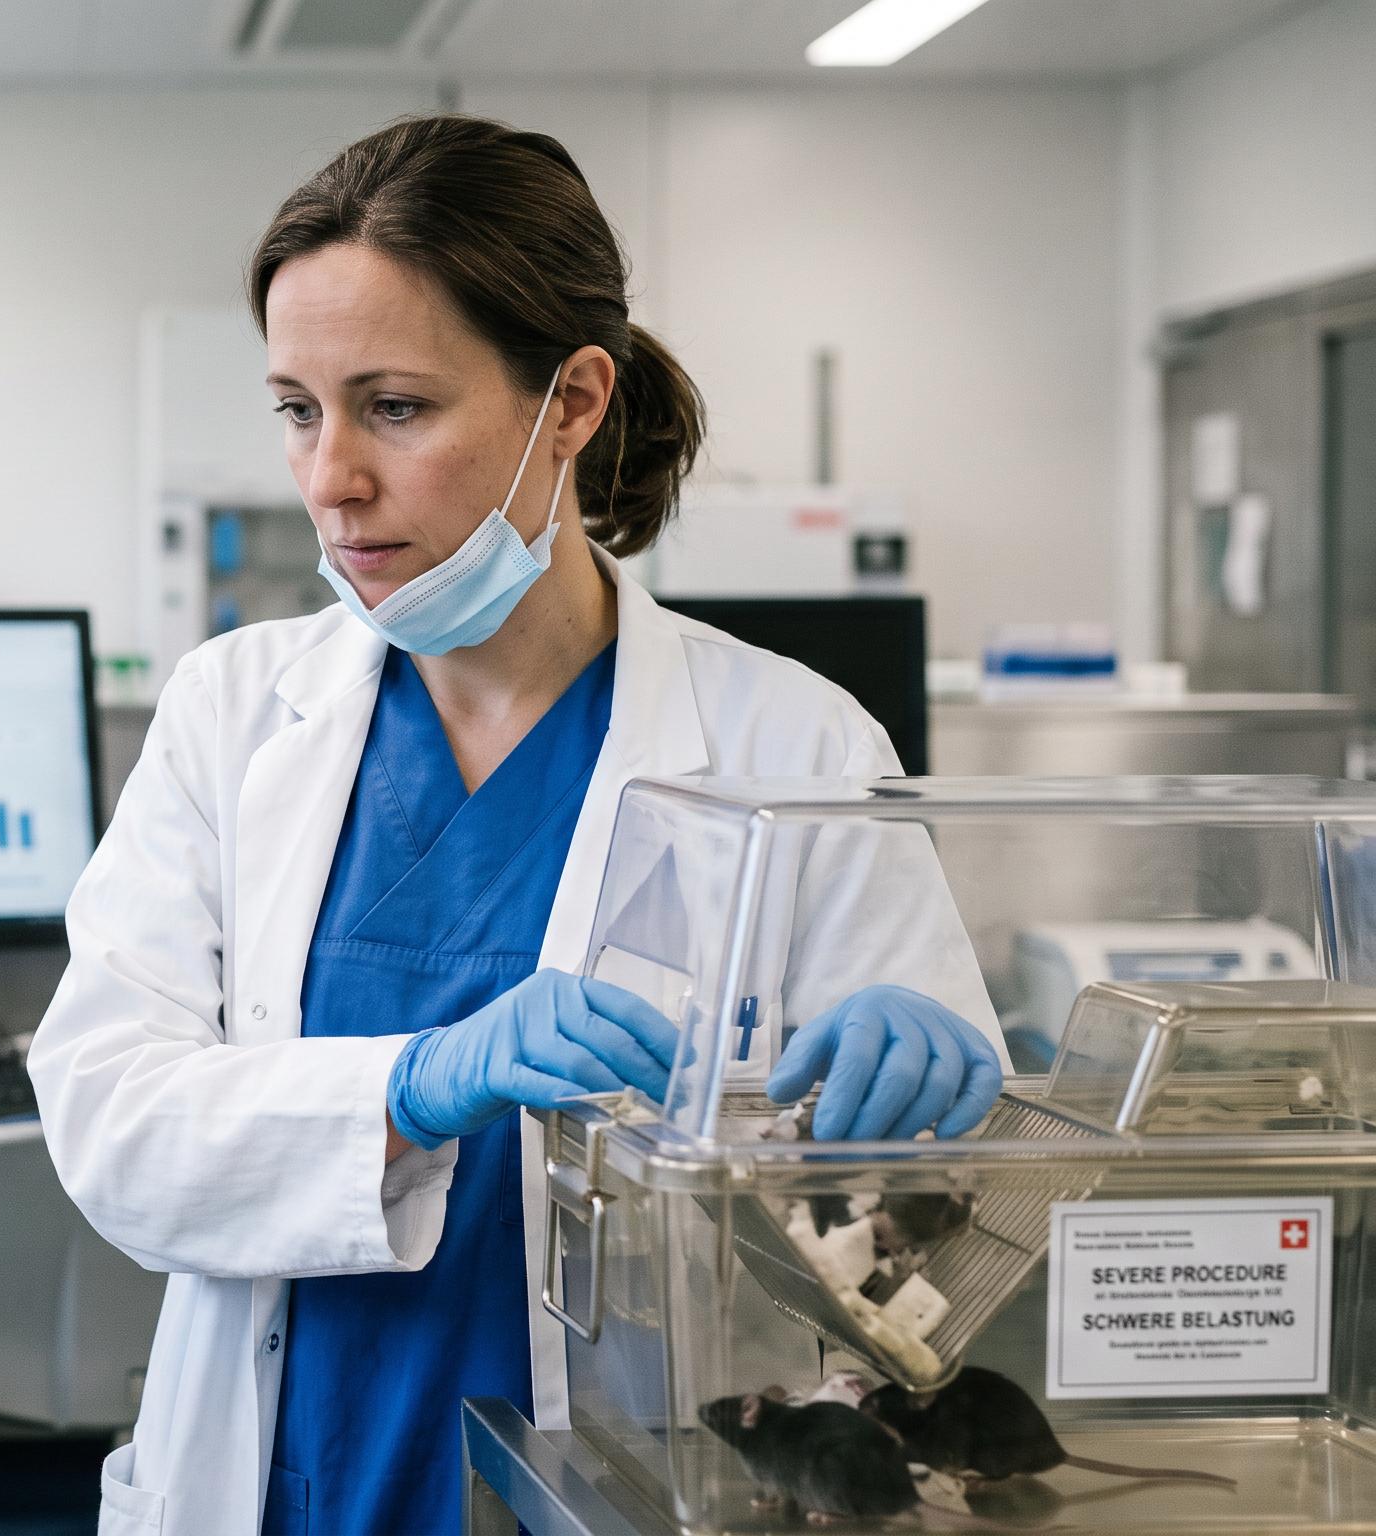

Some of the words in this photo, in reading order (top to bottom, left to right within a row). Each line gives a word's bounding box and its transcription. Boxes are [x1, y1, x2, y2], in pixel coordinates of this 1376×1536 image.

[1093, 1266, 1166, 1285] SEVERE
[1171, 1264, 1287, 1283] PROCEDURE
[1083, 1311, 1175, 1331] SCHWERE
[1182, 1309, 1295, 1329] BELASTUNG
